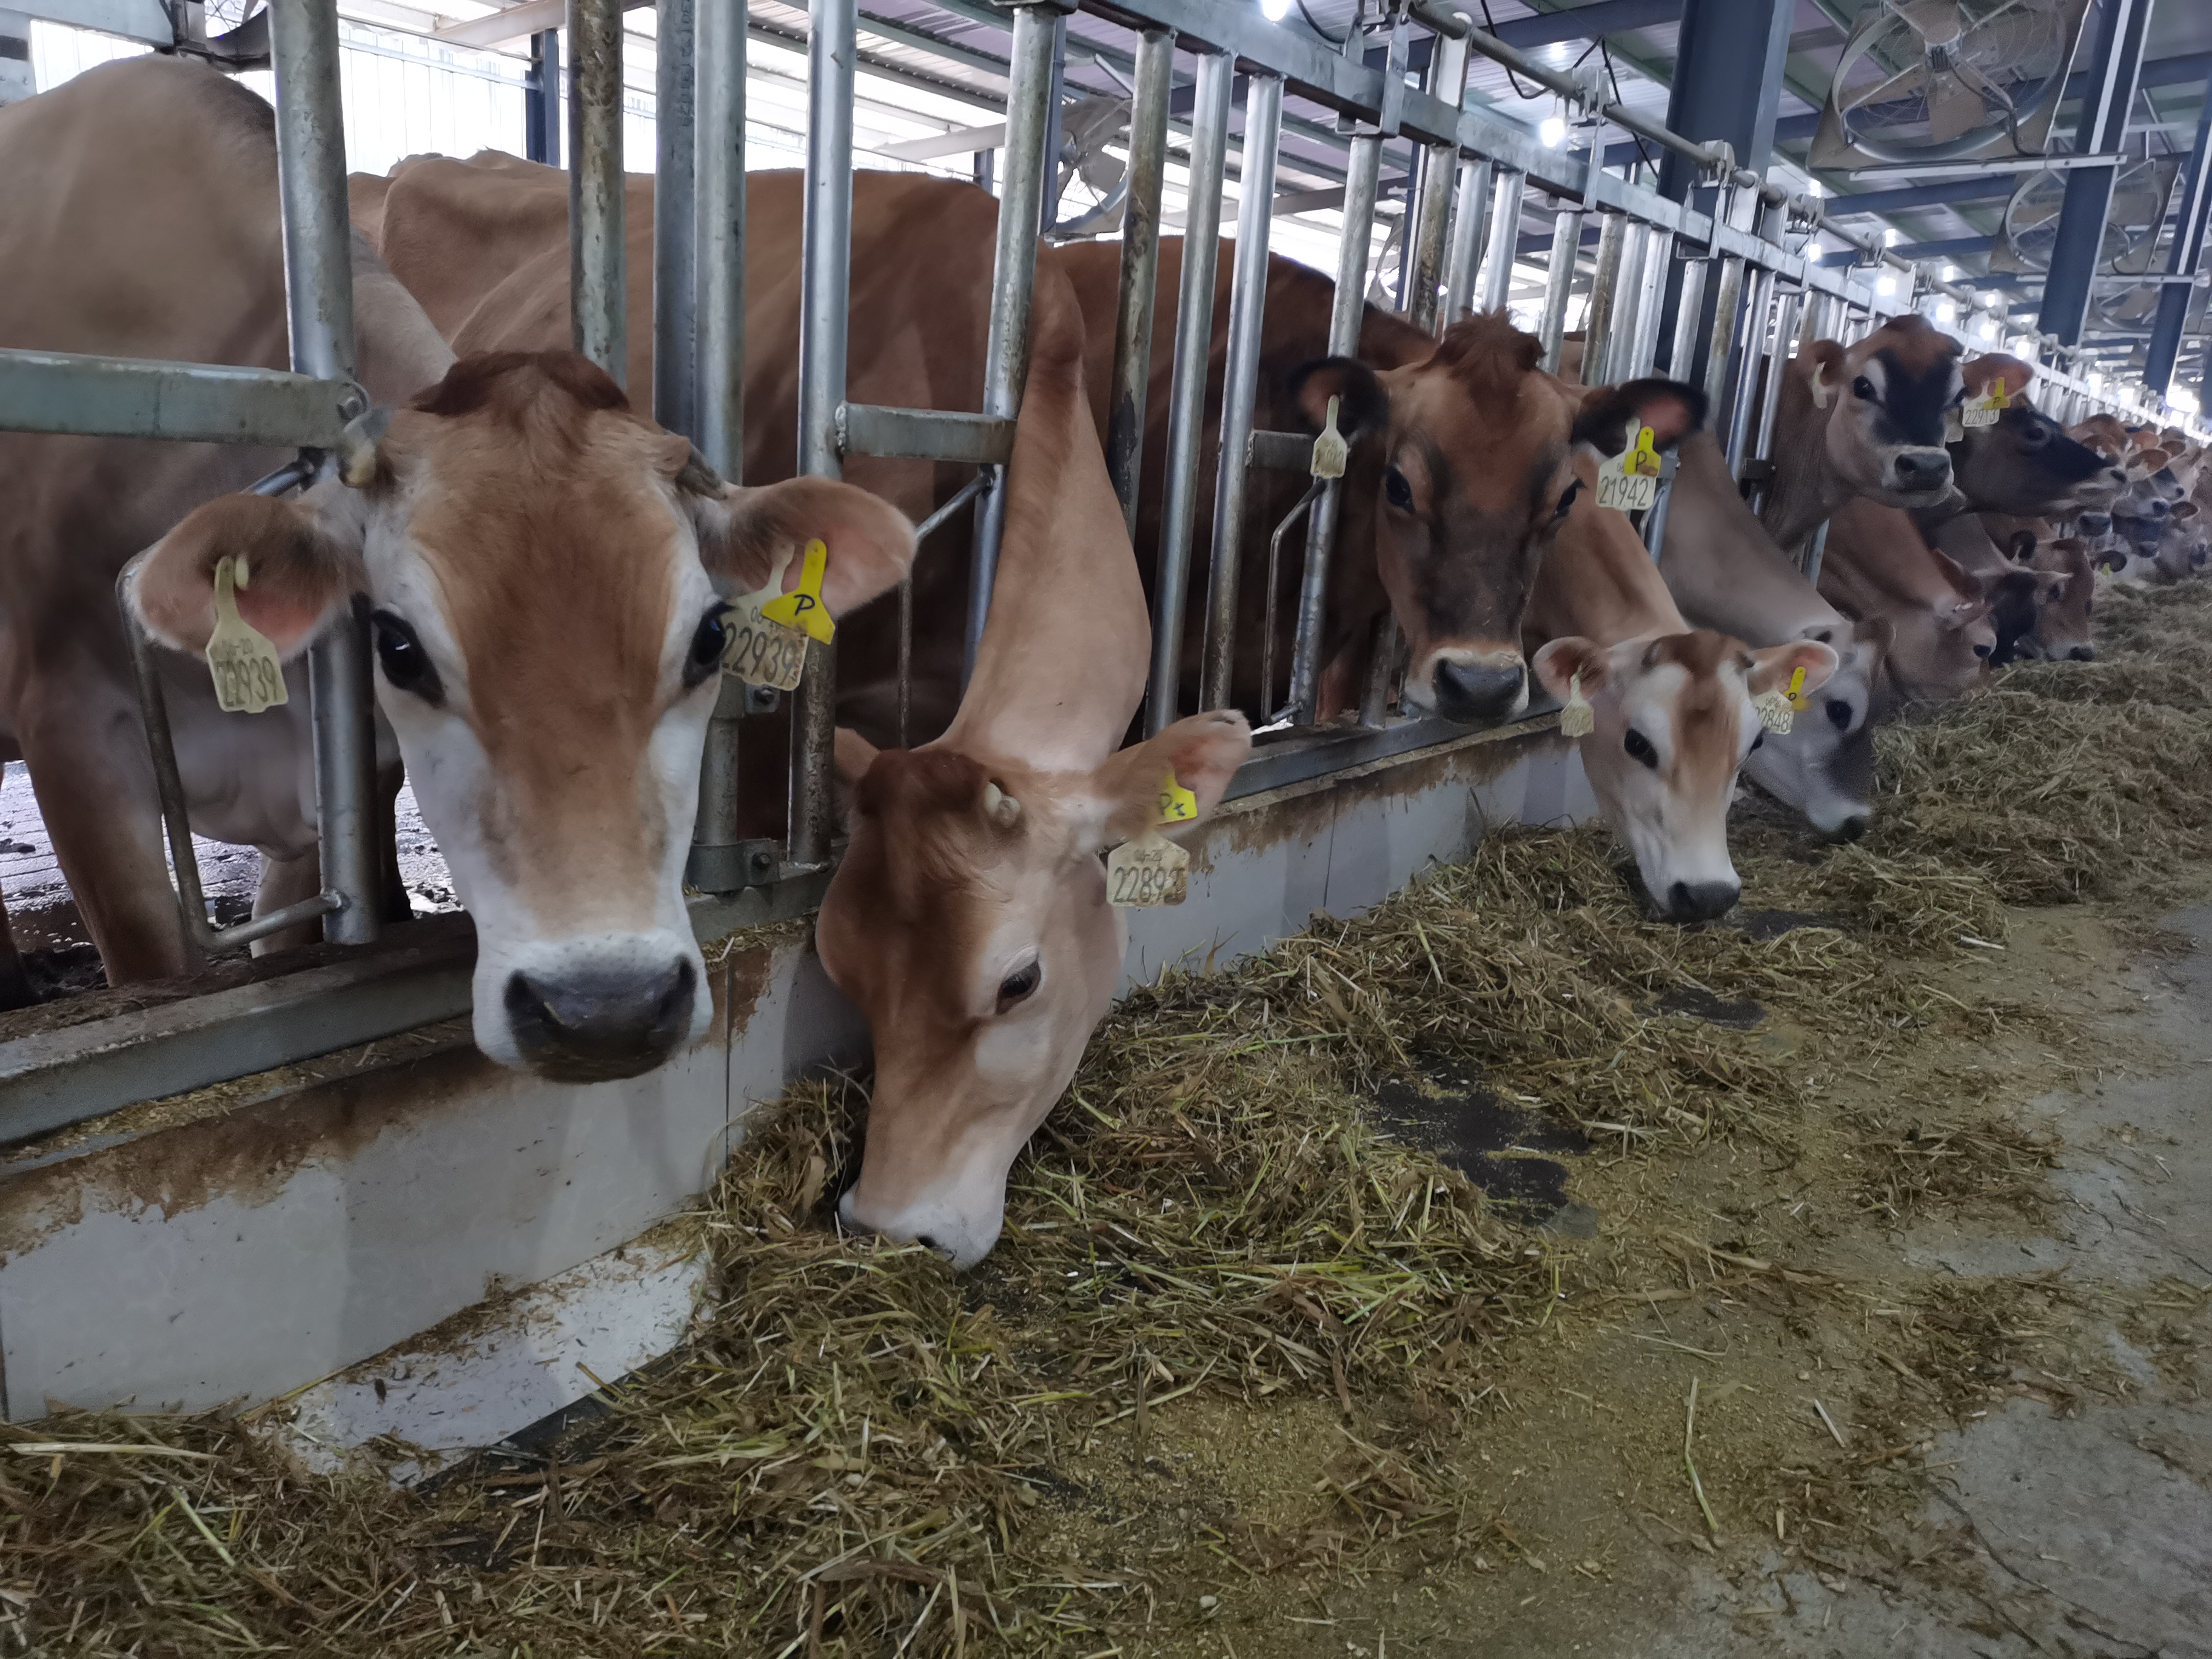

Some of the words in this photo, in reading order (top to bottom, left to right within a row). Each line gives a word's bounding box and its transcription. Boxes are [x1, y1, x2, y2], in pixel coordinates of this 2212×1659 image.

[1635, 450, 1647, 471] P
[1598, 475, 1649, 506] 21942
[794, 594, 815, 616] P
[722, 622, 797, 686] 22939
